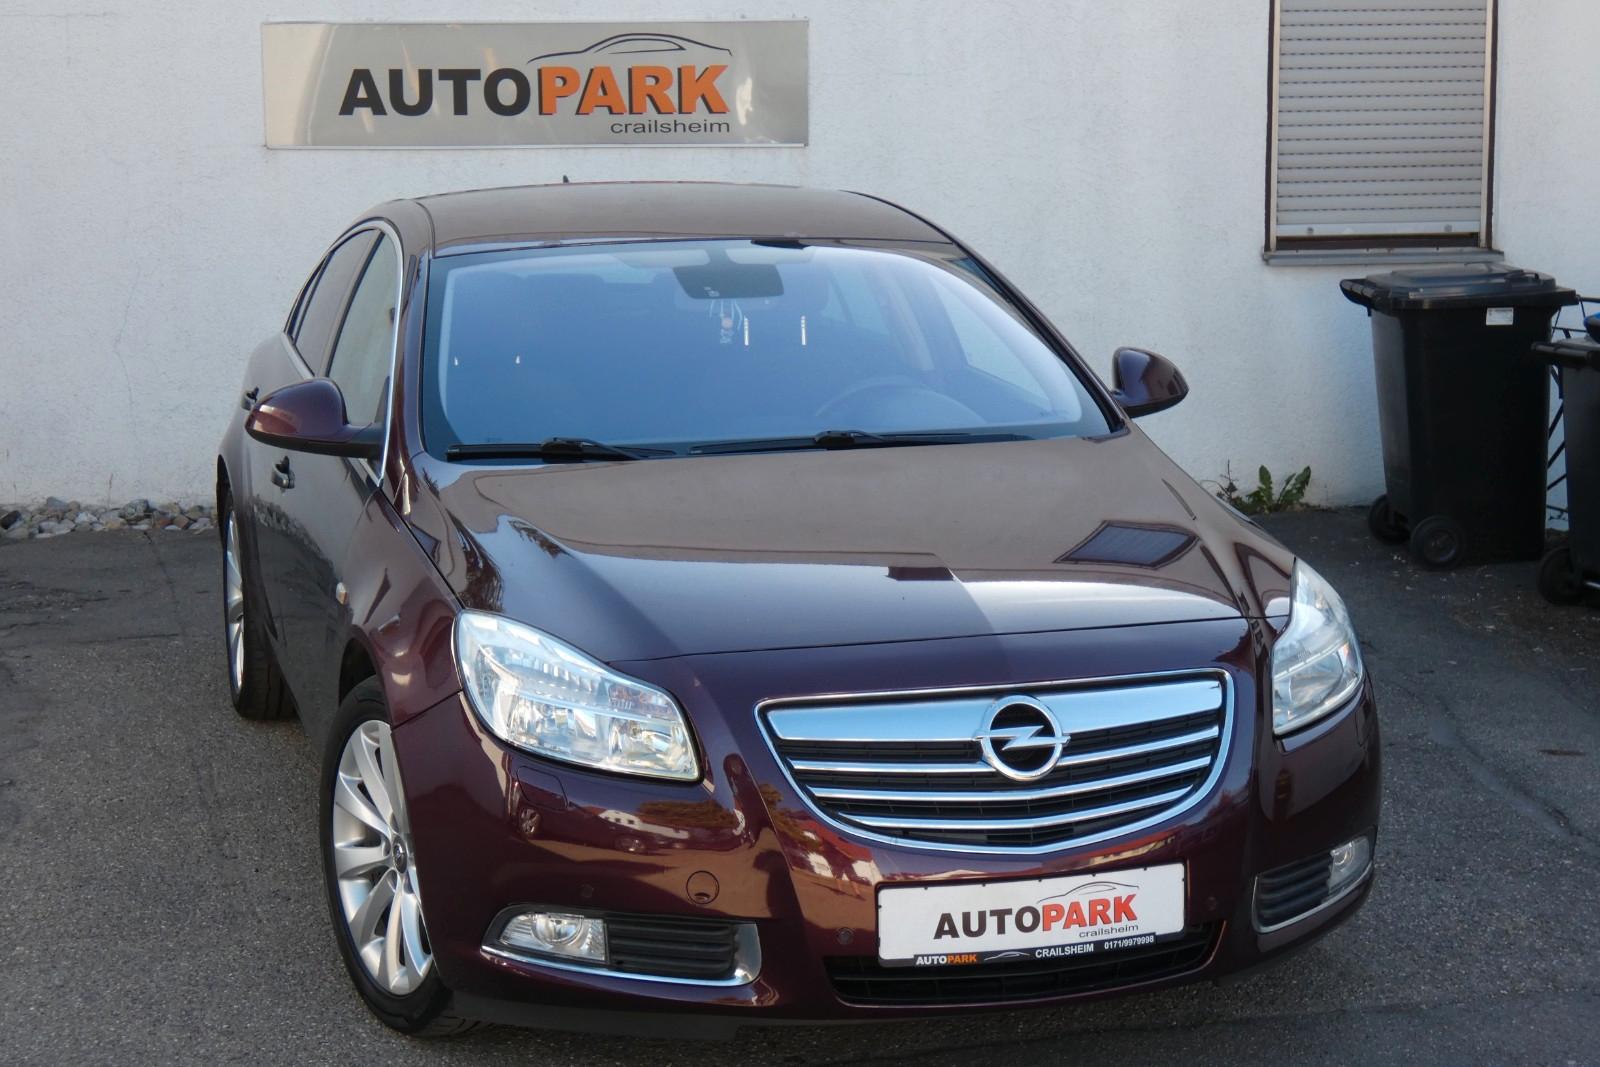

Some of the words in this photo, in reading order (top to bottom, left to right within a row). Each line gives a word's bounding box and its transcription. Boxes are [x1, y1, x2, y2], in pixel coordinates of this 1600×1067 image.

[338, 65, 730, 116] AUTOPARK
[610, 119, 730, 134] crailsheim
[933, 894, 1138, 939] AUTOPARK
[1079, 924, 1139, 938] crailsheim
[916, 953, 977, 965] AUTOPARK
[1035, 943, 1094, 958] CRAILSHEIM
